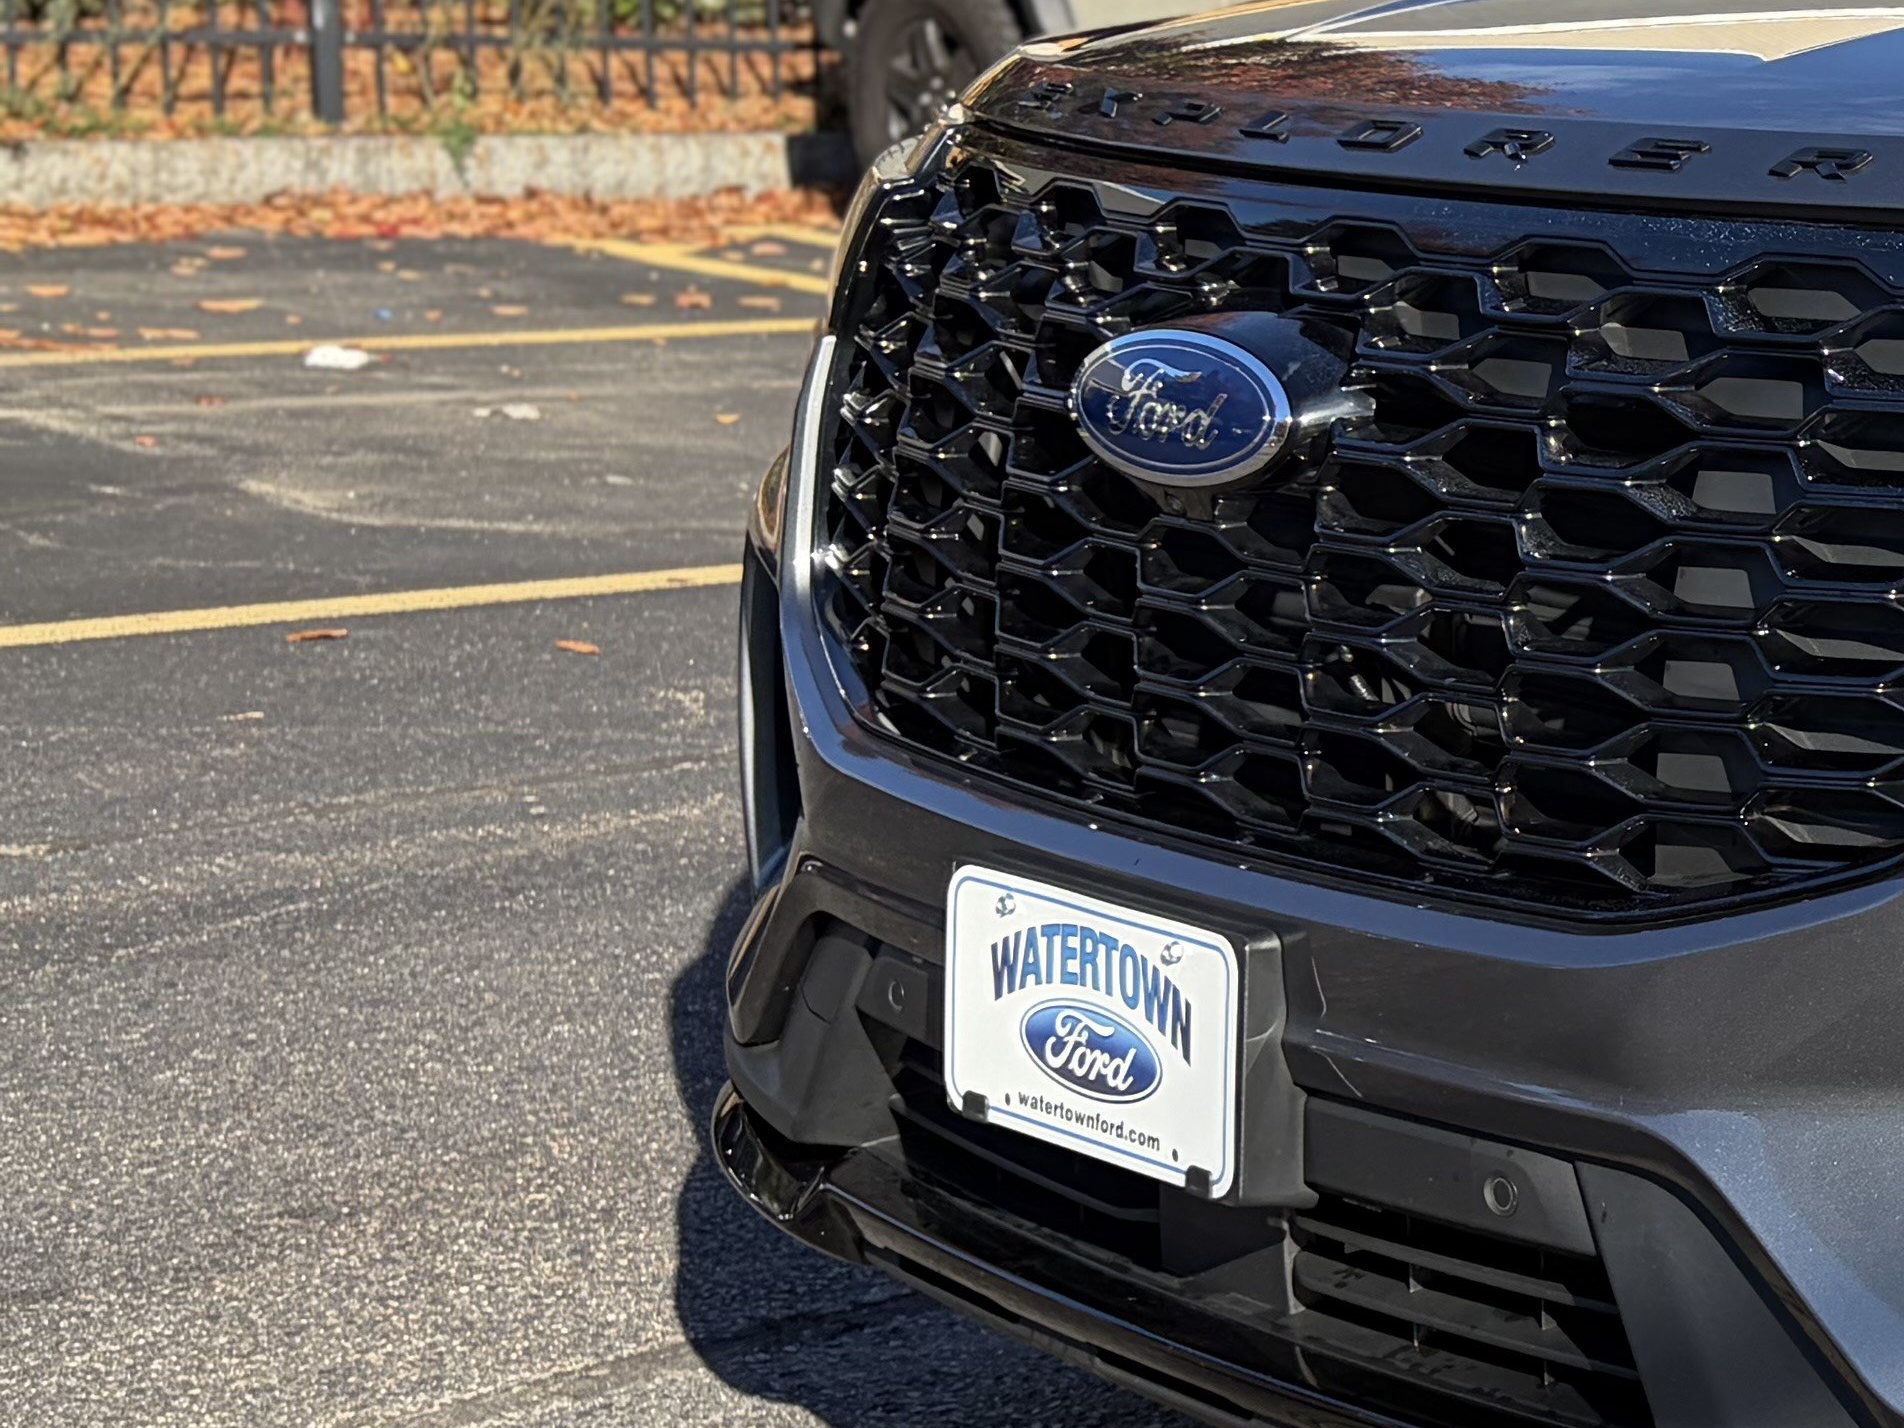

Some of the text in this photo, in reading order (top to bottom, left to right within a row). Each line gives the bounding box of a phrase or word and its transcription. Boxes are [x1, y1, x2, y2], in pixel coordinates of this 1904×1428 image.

[1108, 358, 1228, 450] Ford
[990, 923, 1192, 1068] WATERTOWN
[1045, 1009, 1135, 1092] Ford
[1018, 1091, 1161, 1152] watertownford.com
